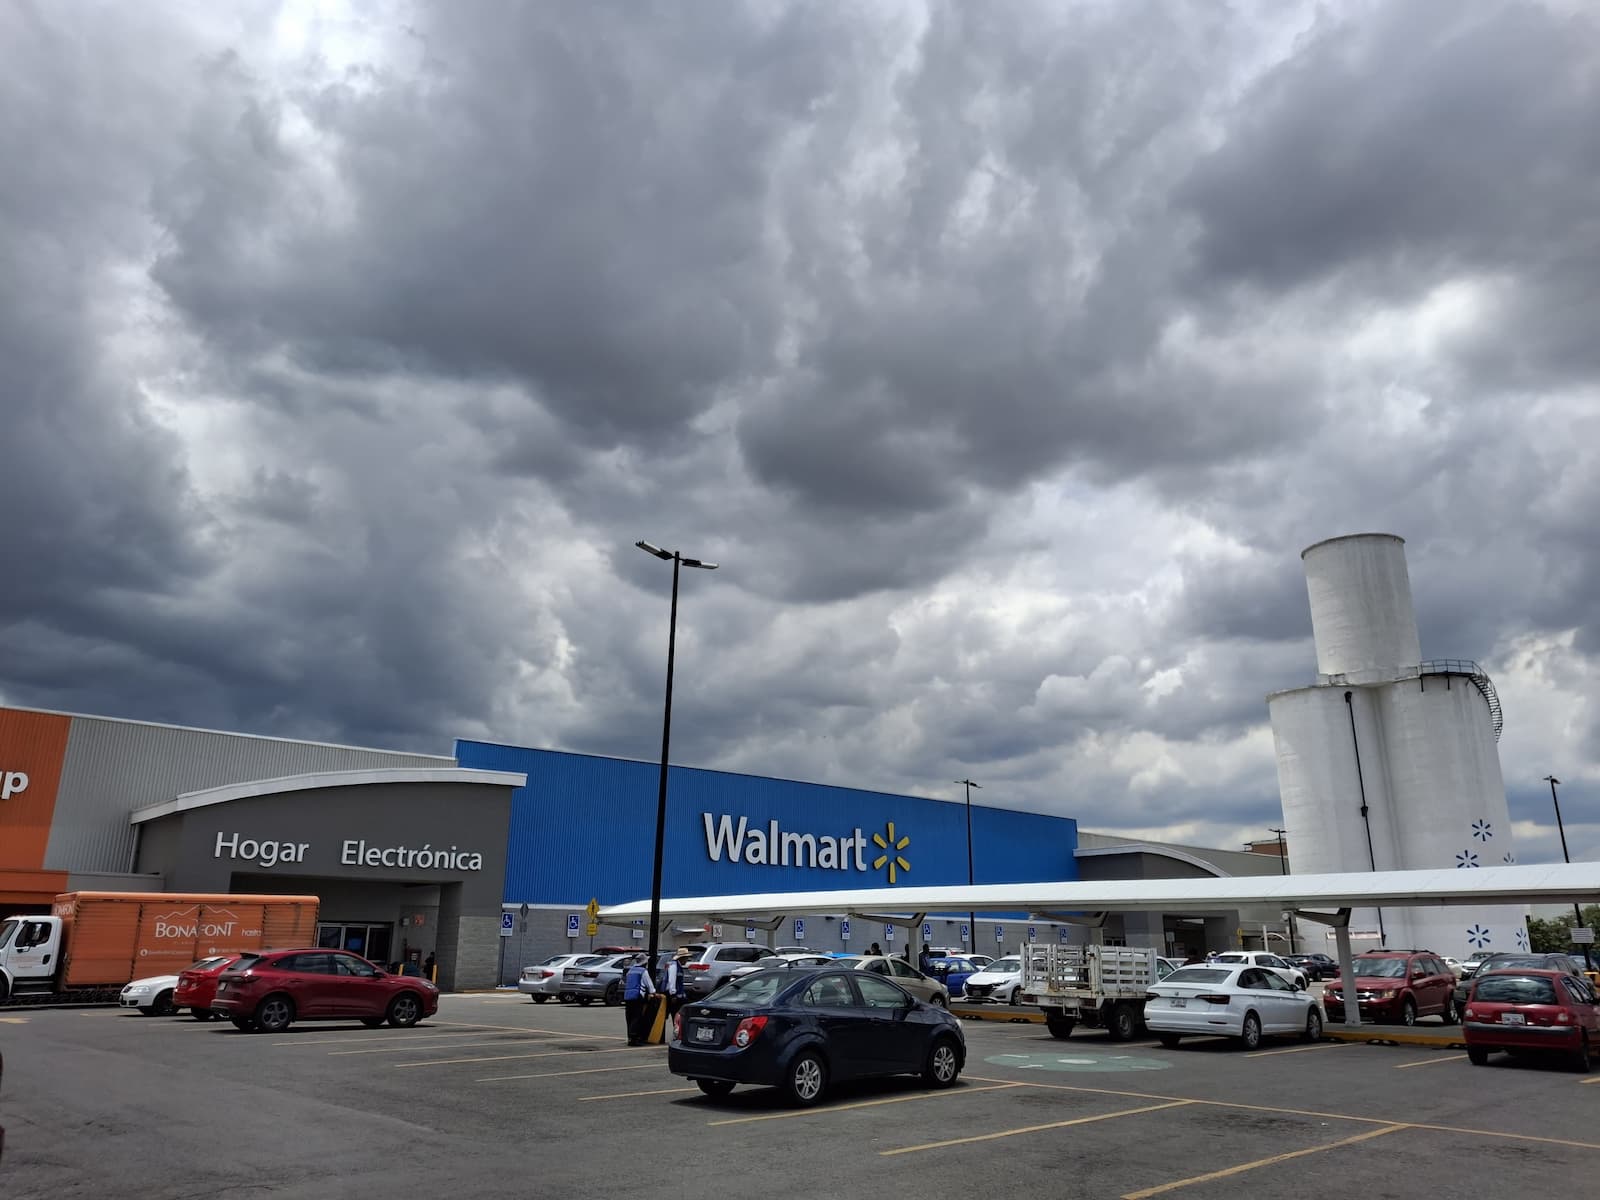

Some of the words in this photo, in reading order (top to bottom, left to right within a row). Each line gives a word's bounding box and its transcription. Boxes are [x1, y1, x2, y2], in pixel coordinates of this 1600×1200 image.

[0, 771, 29, 800] p
[214, 831, 310, 868] Hogar
[340, 839, 483, 871] Electrónica
[703, 812, 868, 872] Walmart
